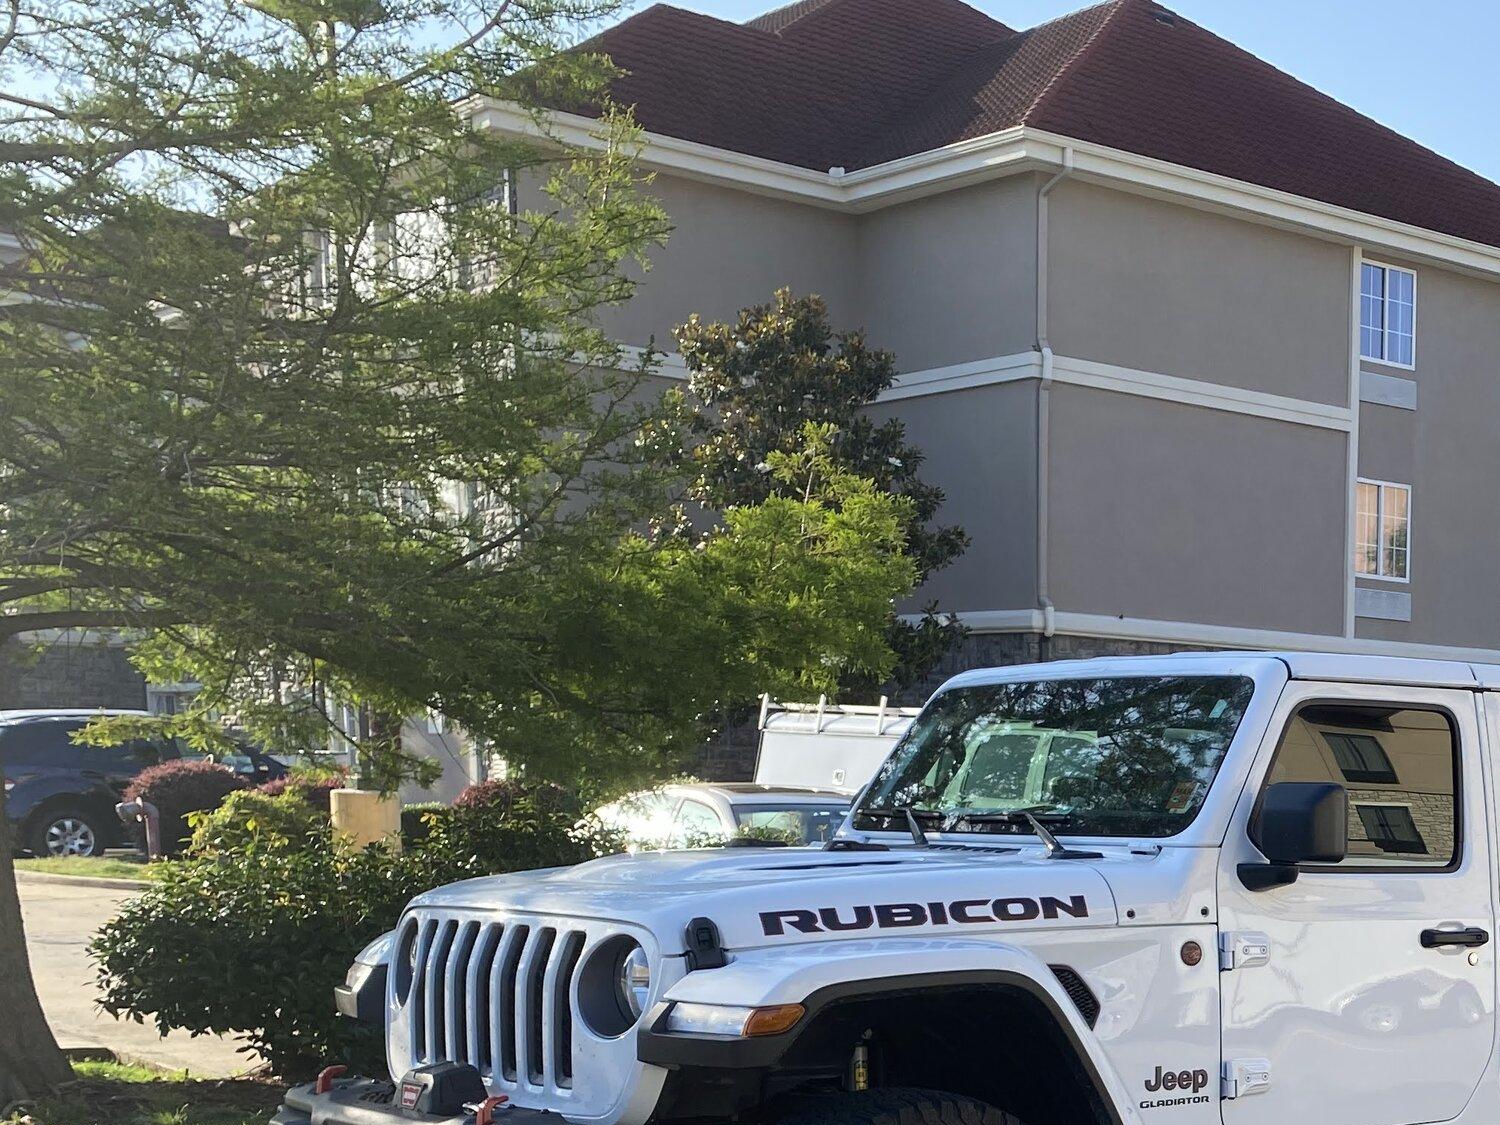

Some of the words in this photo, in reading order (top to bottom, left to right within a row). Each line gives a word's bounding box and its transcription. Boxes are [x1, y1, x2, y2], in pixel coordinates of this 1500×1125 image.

[759, 894, 1090, 937] RUBICON
[1144, 1065, 1209, 1094] Jeep
[1139, 1095, 1210, 1109] GLADIATOR
